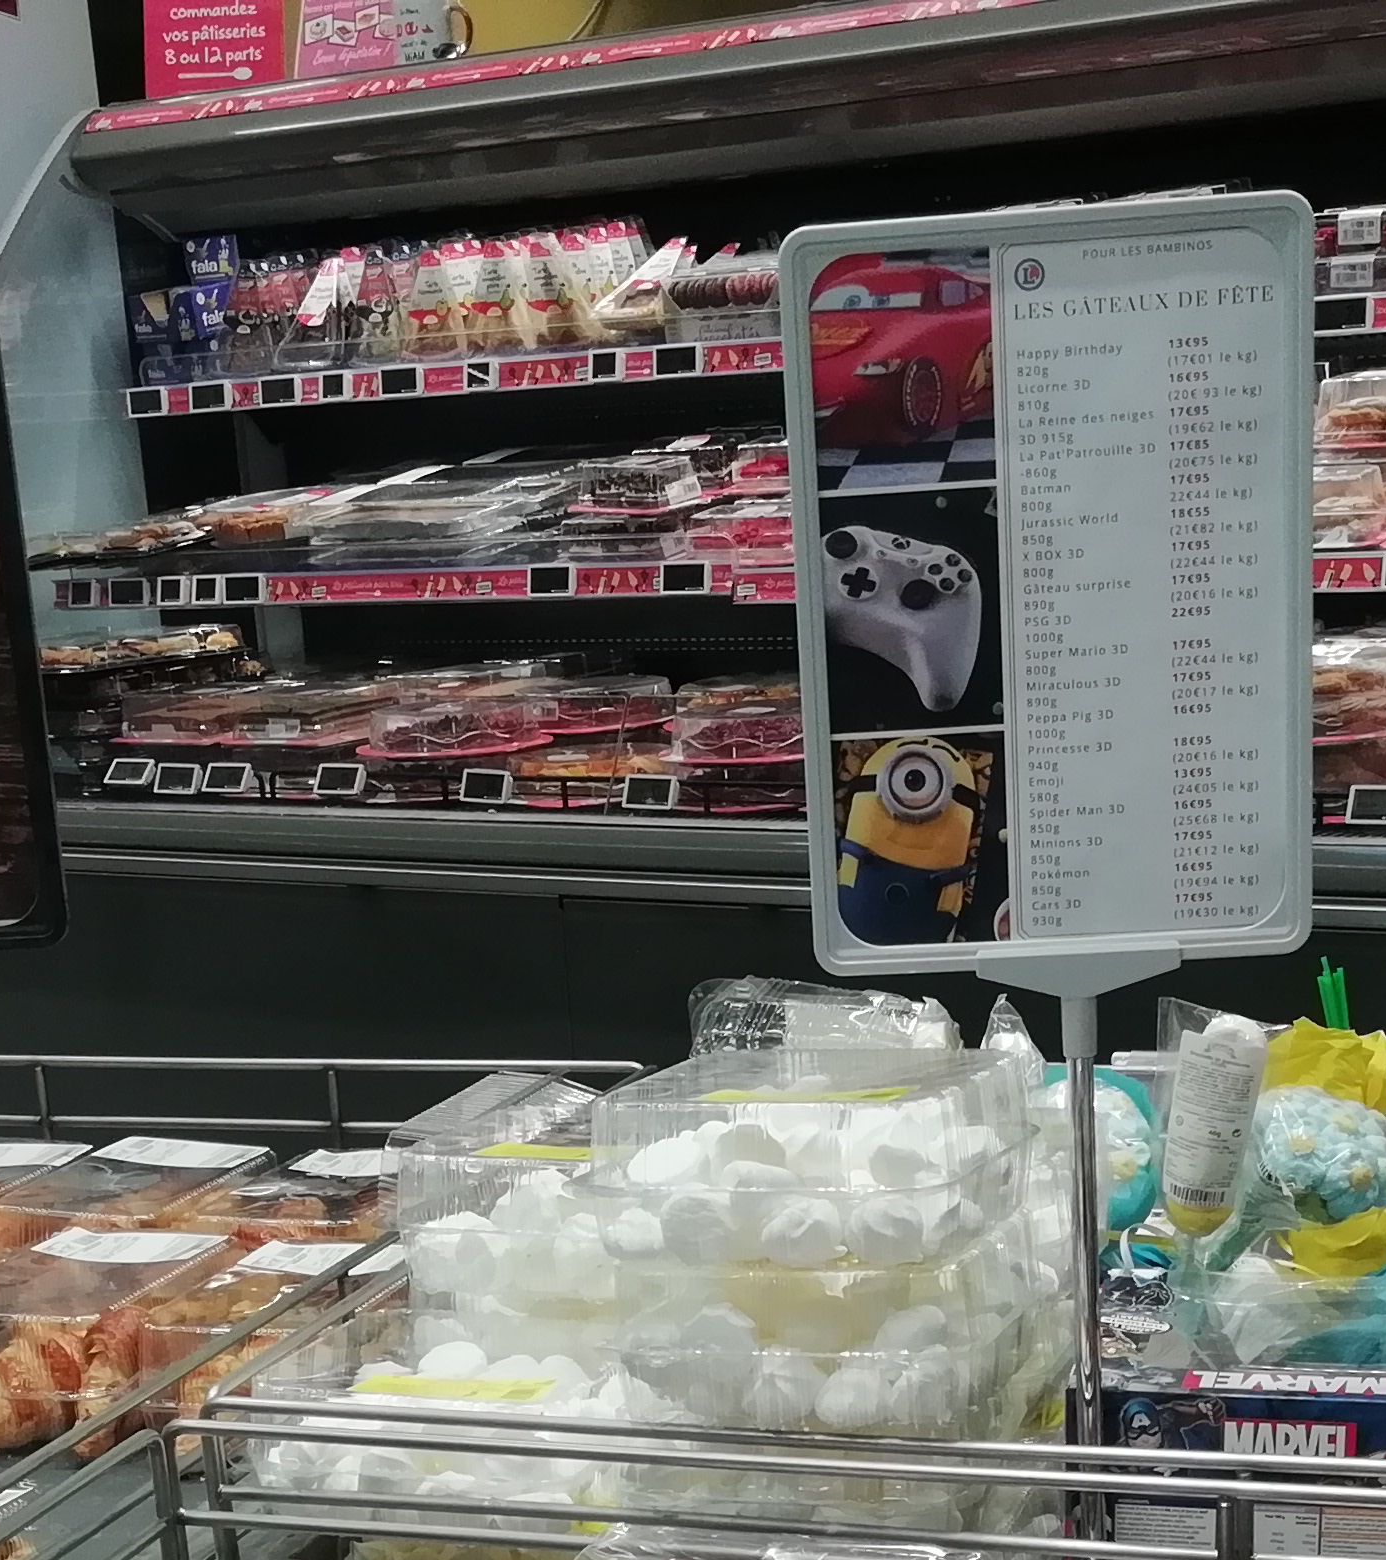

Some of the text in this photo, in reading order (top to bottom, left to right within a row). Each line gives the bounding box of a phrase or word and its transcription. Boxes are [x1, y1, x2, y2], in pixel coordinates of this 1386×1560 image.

[170, 2, 257, 17] commandez
[163, 24, 266, 45] vos pâtisseries
[165, 51, 177, 64] 8
[181, 52, 200, 63] ou
[204, 48, 221, 63] 12
[1083, 240, 1212, 259] POUR LES BAMBINOS
[191, 259, 219, 274] fala
[1015, 285, 1273, 319] LES GÂTEAUX DE FÊTE
[1169, 337, 1208, 348] 13€95
[1017, 344, 1122, 361] Happy Birthday
[1018, 366, 1048, 378] 820g
[1170, 371, 1208, 382] 16€95
[1018, 379, 1090, 394] Licorne 3D
[1019, 400, 1049, 412] 810g
[1171, 406, 1208, 417] 17€95
[1019, 411, 1153, 428] La Reine des neiges
[1042, 432, 1073, 444] 915g
[1140, 443, 1155, 453] 3D
[1171, 473, 1209, 484] 17€95
[1021, 485, 1071, 495] Batman
[1022, 501, 1052, 513] 800g
[1171, 507, 1209, 518] 18€55
[1021, 513, 1118, 531] Jurassic World
[1022, 535, 1053, 546] 850g
[1172, 540, 1209, 551] 17€95
[1036, 549, 1084, 560] BOX 3D
[1024, 568, 1053, 579] 800g
[1172, 573, 1210, 584] 17€95
[1024, 580, 1130, 594] Gâteau surprise
[1025, 600, 1054, 612] 890g
[1172, 606, 1210, 617] 22€95
[1025, 615, 1071, 626] PSG 3D
[1026, 632, 1063, 644] 1000g
[1173, 639, 1211, 650] 17€95
[1025, 644, 1128, 660] Super Mario 3D
[1026, 666, 1056, 677] 800g
[1173, 672, 1211, 682] 17€95
[1027, 677, 1120, 691] Miraculous 3D
[1027, 698, 1056, 708] 890g
[1174, 704, 1211, 714] 16€95
[1028, 710, 1113, 724] Peppa Pig 3D
[1029, 729, 1065, 740] 1000g
[1174, 736, 1211, 746] 18€95
[1028, 742, 1112, 754] Princesse 3D
[1029, 761, 1058, 772] 940g
[1175, 767, 1211, 778] 13€95
[1029, 777, 1063, 788] Emoji
[1030, 792, 1059, 804] 580g
[1175, 799, 1211, 809] 16€95
[1030, 804, 1124, 819] Spider Man 3D
[1030, 824, 1059, 835] 850g
[1175, 831, 1212, 841] 17€95
[1031, 837, 1102, 848] Minions 3D
[1031, 855, 1060, 866] 850g
[1176, 862, 1212, 871] 16€95
[1032, 870, 1090, 879] Pokémon
[1032, 886, 1061, 897] 850g
[1176, 892, 1212, 903] 17€95
[1032, 900, 1081, 910] Cars 3D
[1033, 916, 1062, 927] 930g
